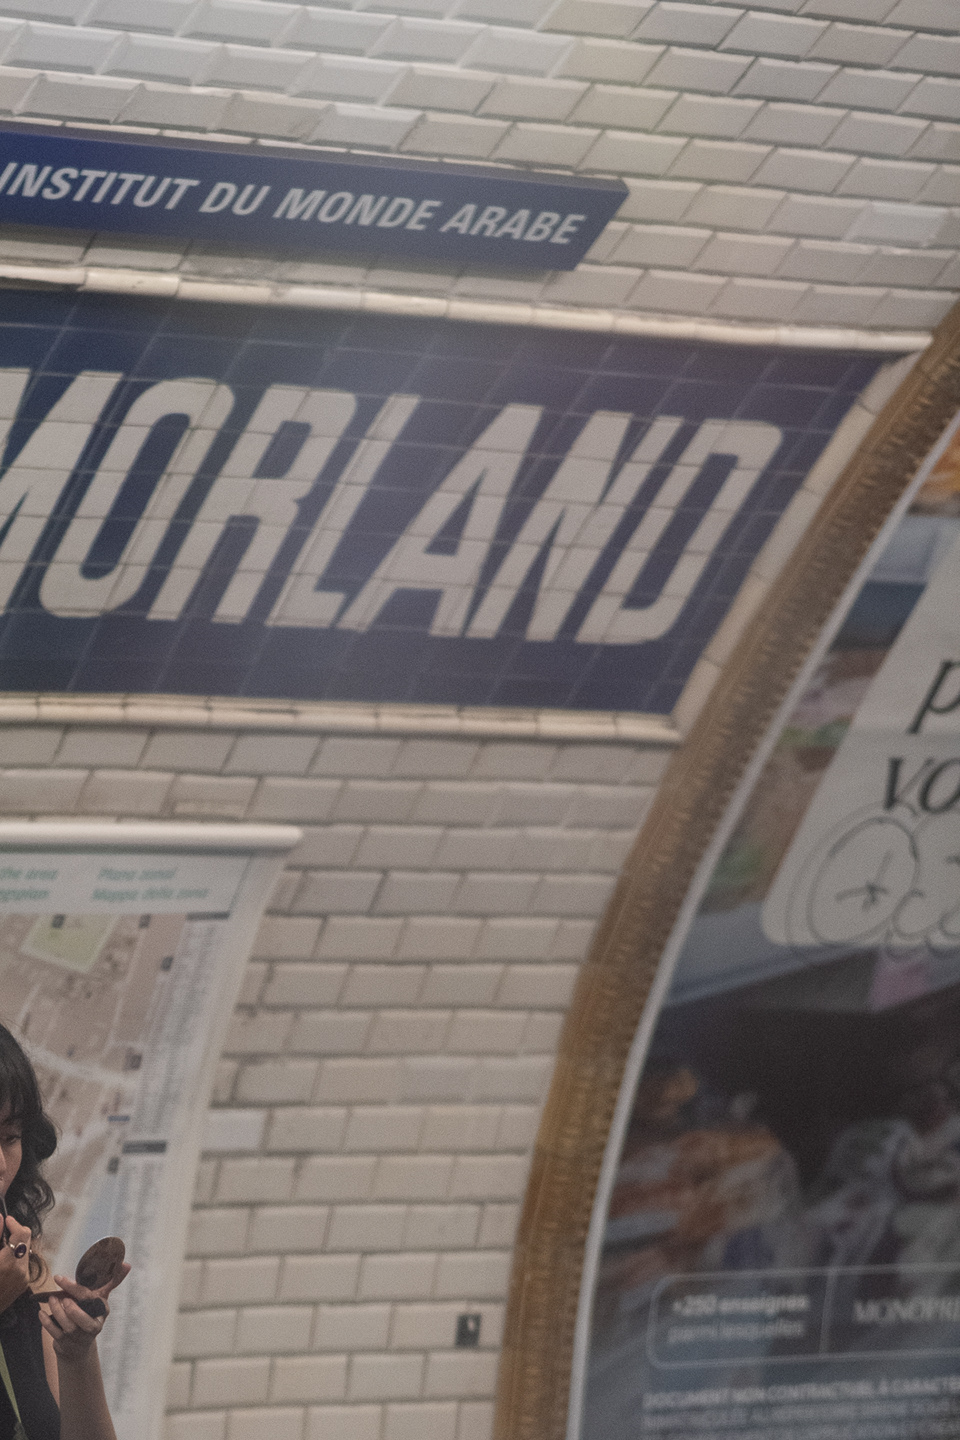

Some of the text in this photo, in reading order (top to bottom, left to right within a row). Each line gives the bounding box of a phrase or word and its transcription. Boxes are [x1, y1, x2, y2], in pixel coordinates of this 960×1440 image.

[199, 180, 263, 216] DU
[272, 187, 439, 233] MONDE
[438, 202, 586, 245] ARABE
[24, 869, 59, 880] area
